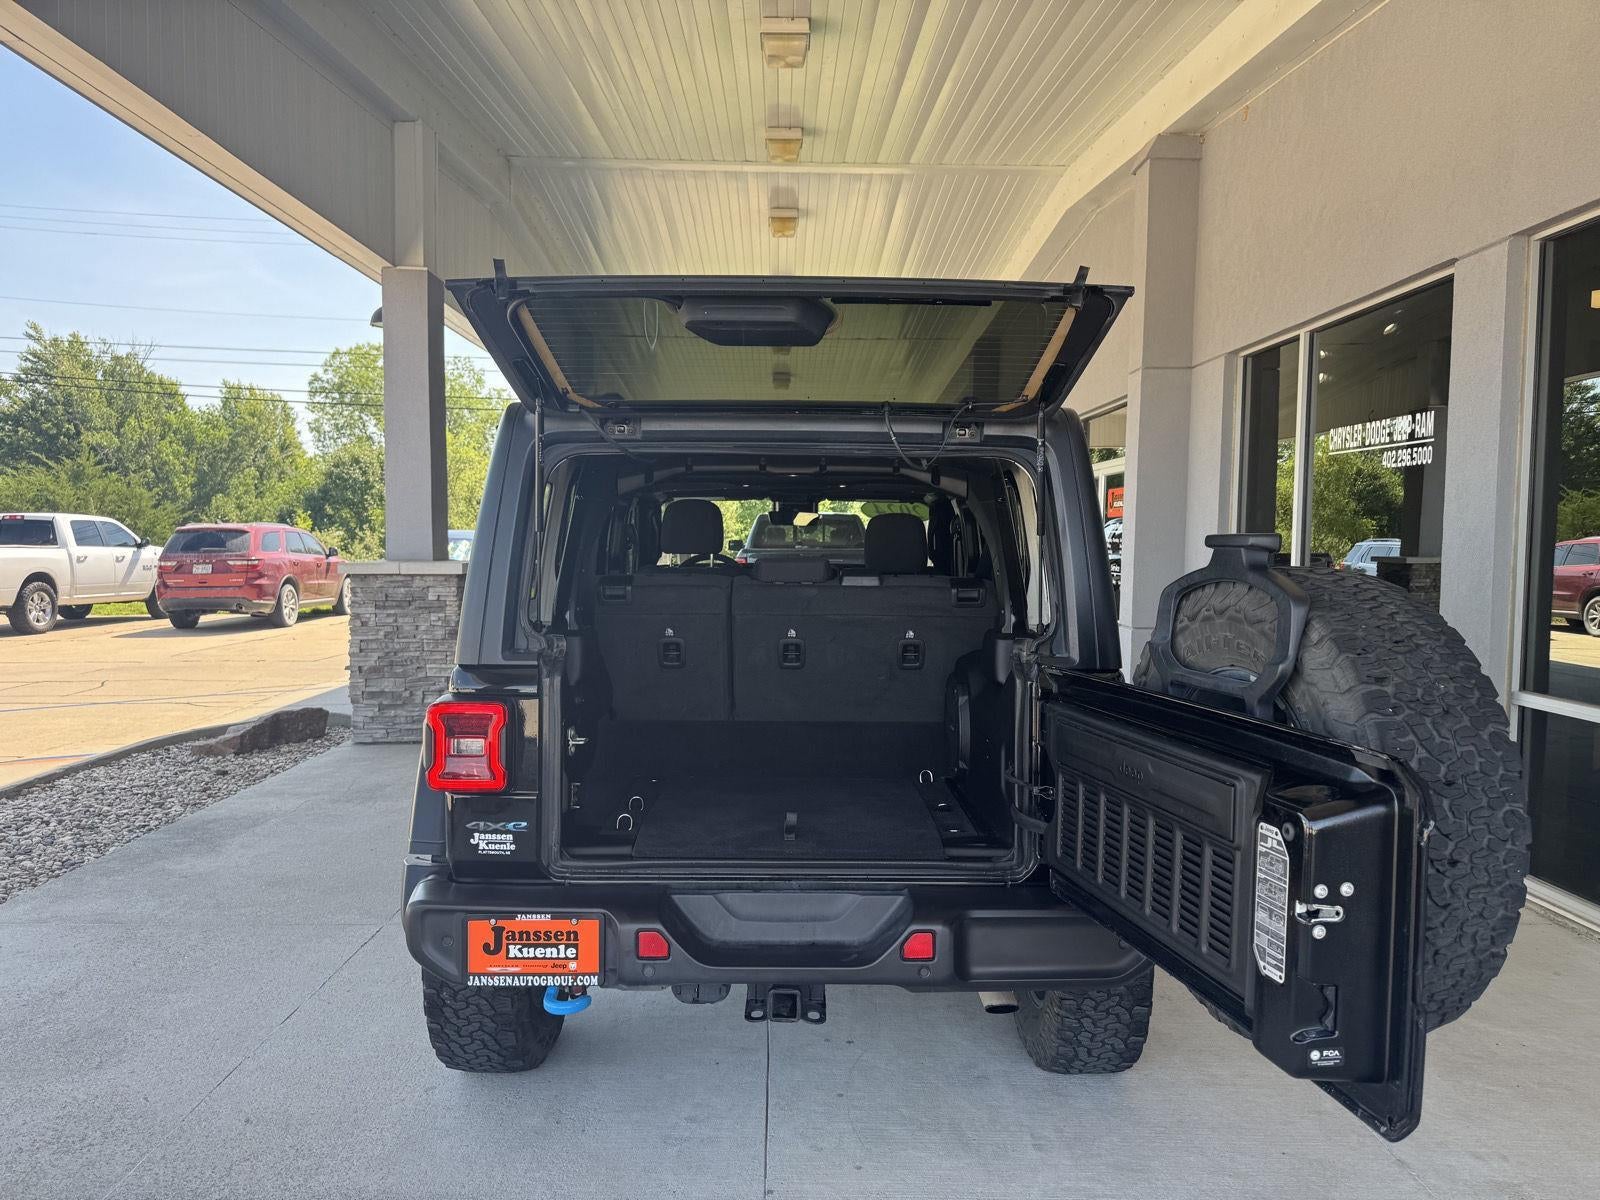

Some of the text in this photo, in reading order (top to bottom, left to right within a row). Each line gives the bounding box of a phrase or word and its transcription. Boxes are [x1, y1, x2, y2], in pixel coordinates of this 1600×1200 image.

[1381, 446, 1433, 468] 402.296.5000
[470, 832, 514, 845] Janssen
[478, 840, 516, 850] Kuenle
[482, 925, 580, 956] Janssen
[508, 944, 577, 959] Kuenle
[550, 962, 567, 970] Jeep
